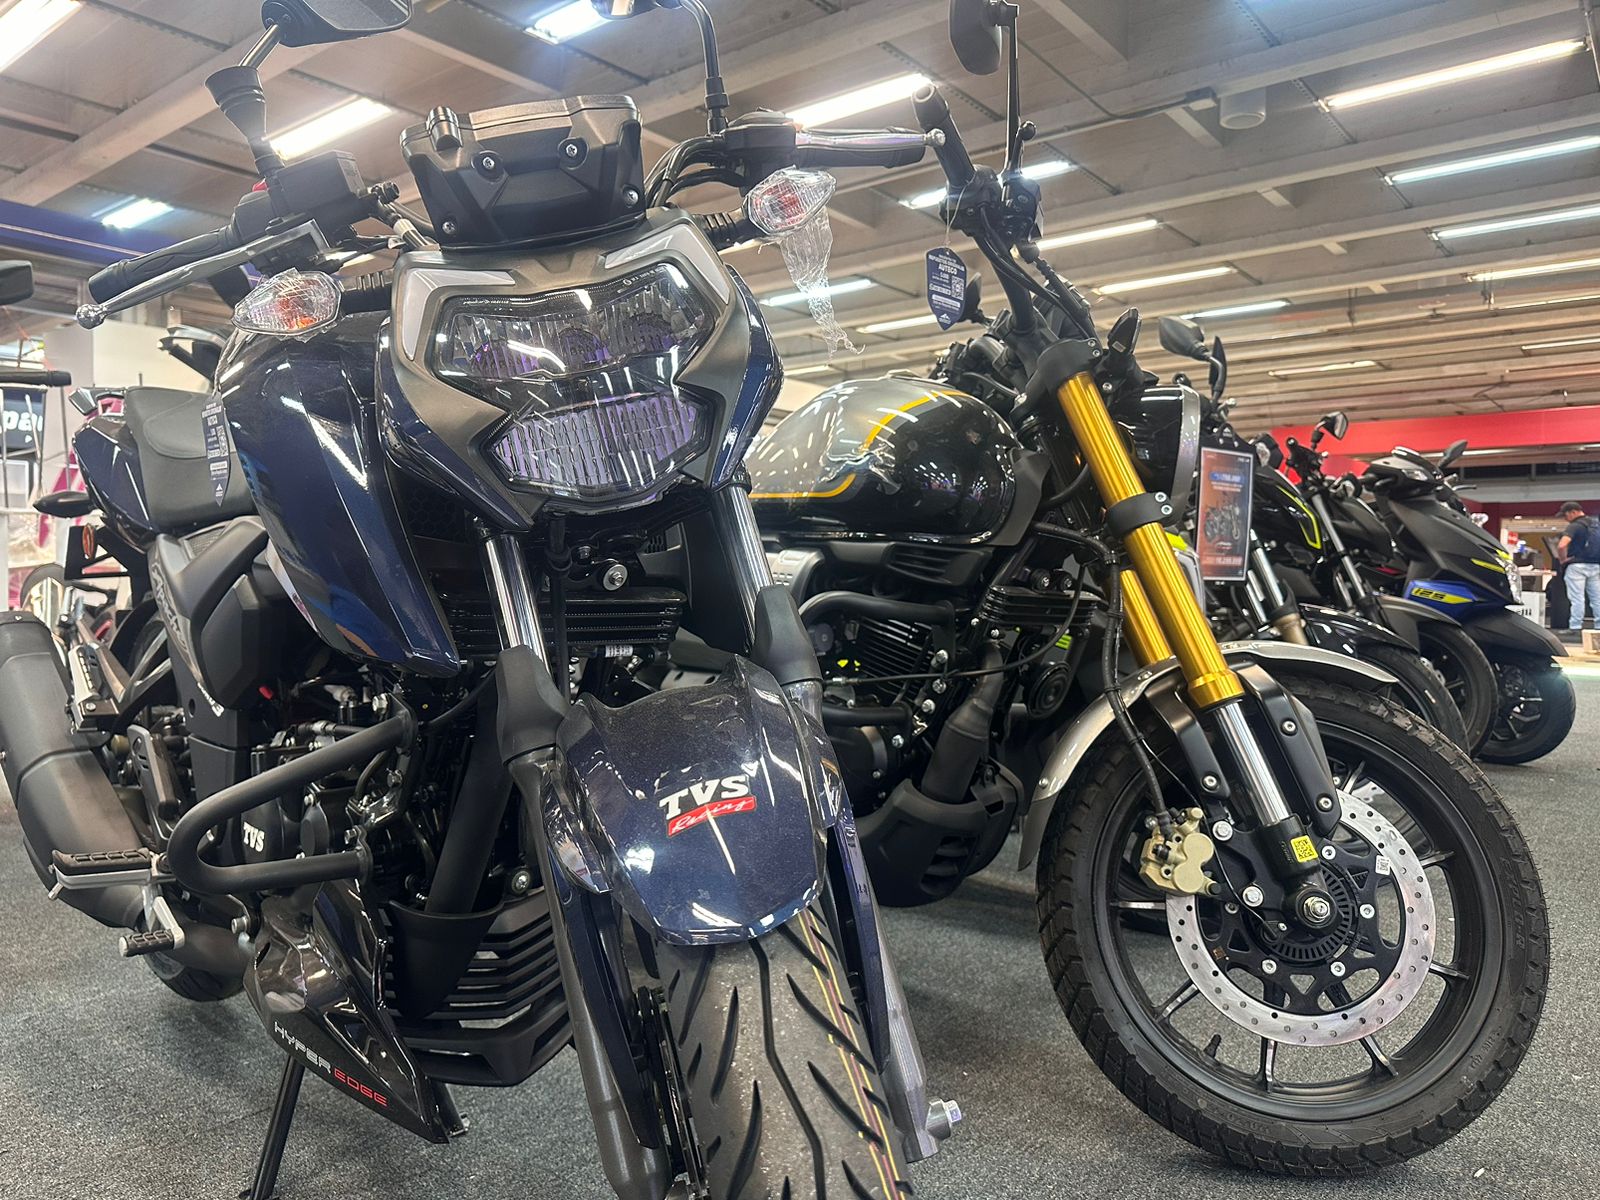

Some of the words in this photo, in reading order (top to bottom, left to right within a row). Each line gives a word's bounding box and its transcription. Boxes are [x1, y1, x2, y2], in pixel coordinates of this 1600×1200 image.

[1414, 588, 1446, 600] 125
[659, 775, 749, 820] TVS
[671, 799, 755, 834] Racing
[243, 821, 265, 852] TVS
[274, 1021, 332, 1074] HYPER
[334, 1068, 388, 1107] EDGE
